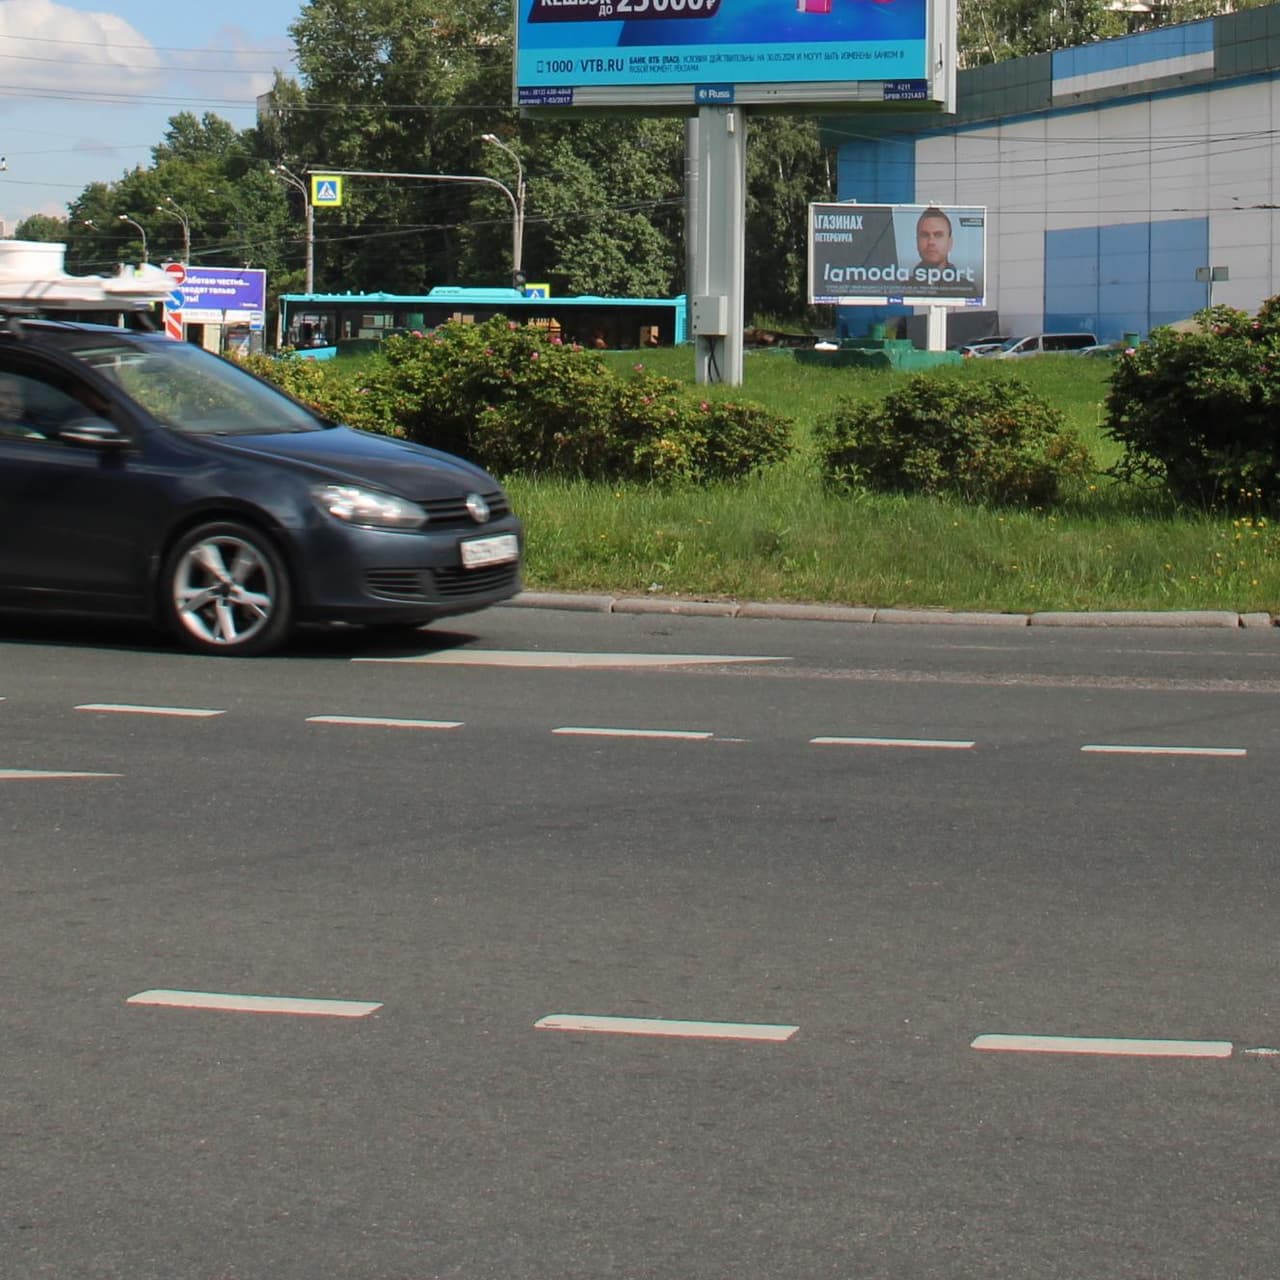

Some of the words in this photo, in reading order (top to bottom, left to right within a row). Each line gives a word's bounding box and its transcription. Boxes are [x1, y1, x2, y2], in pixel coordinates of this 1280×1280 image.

[598, 5, 613, 17] ДО
[546, 59, 573, 73] 1000
[580, 58, 624, 73] VTB.RU
[824, 263, 909, 282] lamoda
[915, 268, 975, 285] sport
